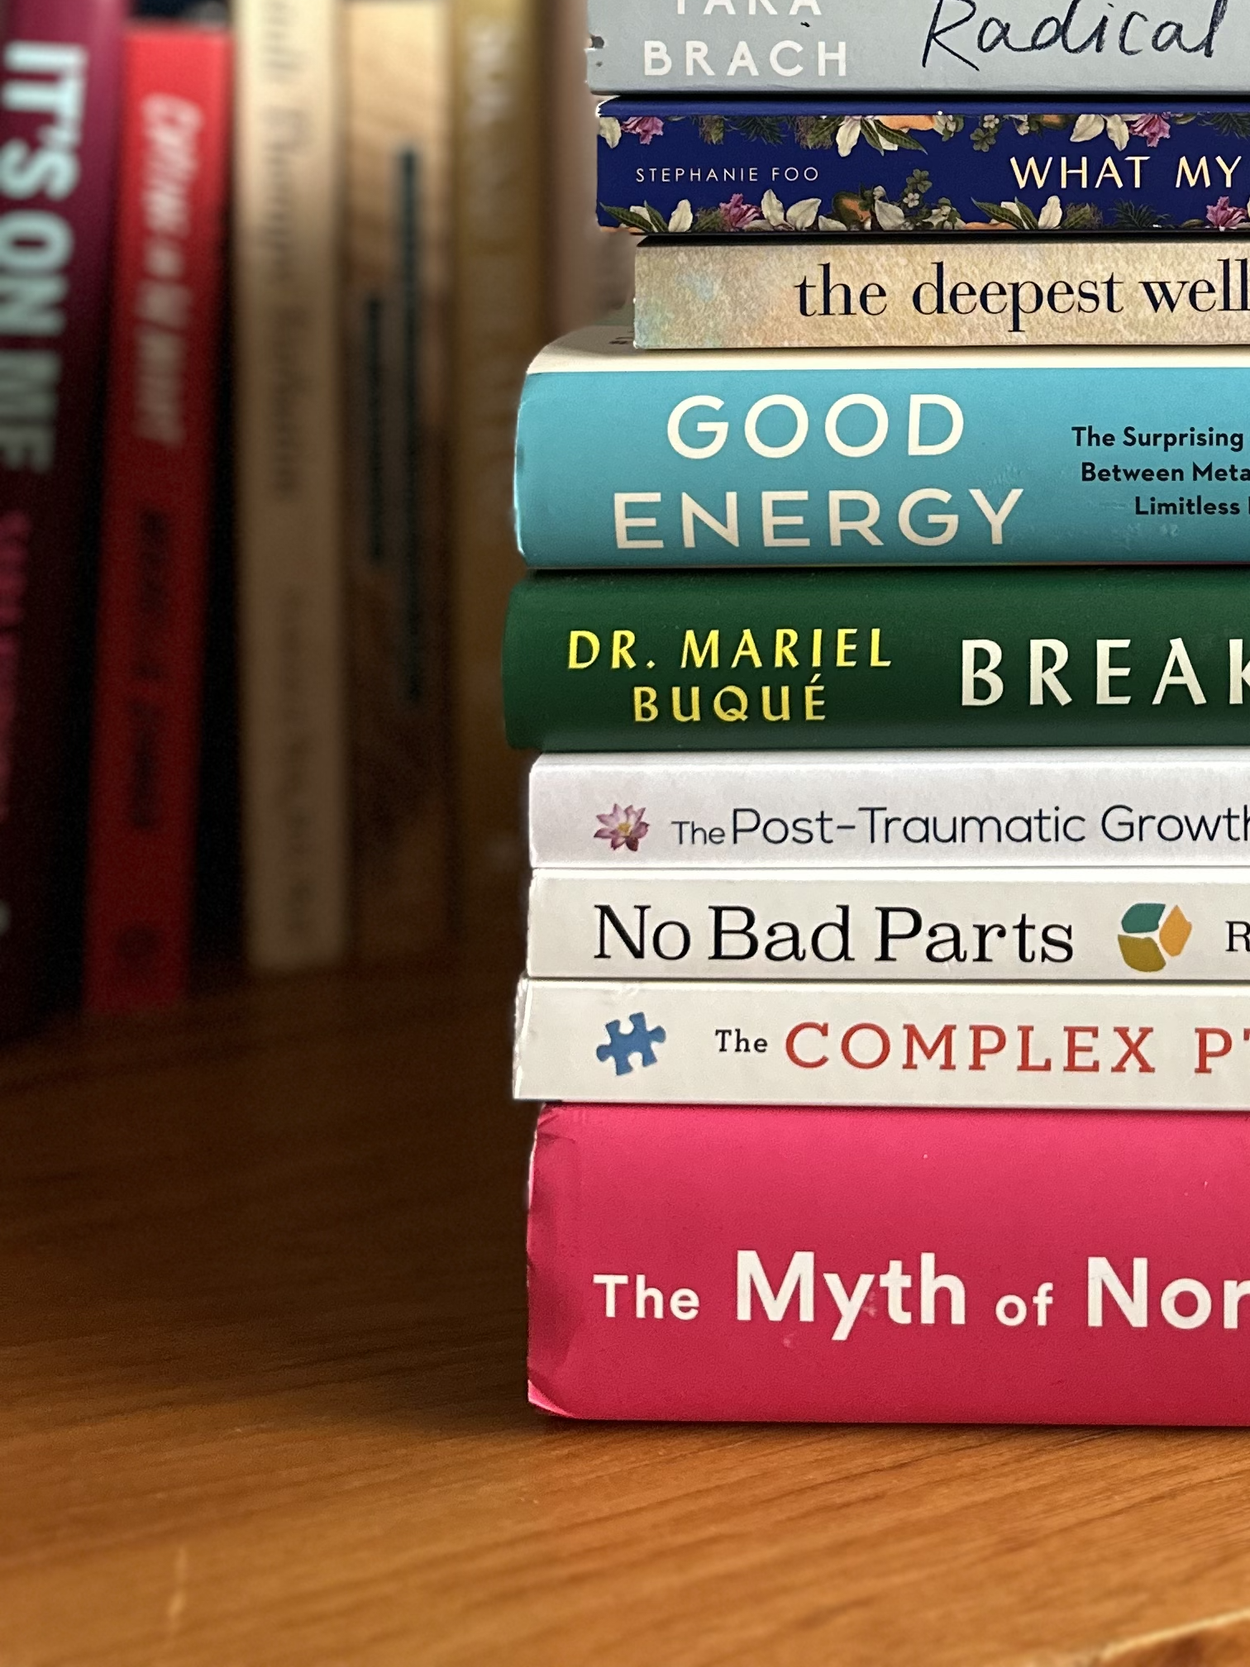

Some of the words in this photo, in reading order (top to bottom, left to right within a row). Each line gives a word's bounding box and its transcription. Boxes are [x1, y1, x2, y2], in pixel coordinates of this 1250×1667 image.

[644, 39, 847, 77] BRACH
[1, 41, 88, 200] IT'S
[635, 167, 758, 183] STEPHANIE
[771, 166, 819, 182] FOO
[1009, 155, 1151, 190] WHAT
[1175, 155, 1242, 188] MY
[0, 209, 74, 336] ON
[793, 262, 888, 317] the
[912, 260, 1124, 333] deepest
[667, 393, 964, 460] GOOD
[1071, 425, 1116, 447] The
[1122, 425, 1244, 453] Surprising
[1081, 461, 1185, 482] Between
[613, 487, 1024, 549] ENERGY
[1135, 494, 1241, 516] Limitless
[568, 629, 656, 669] DR.
[680, 627, 892, 669] MARIEL
[633, 673, 826, 722] BUQUÉ
[670, 820, 726, 845] The
[732, 805, 1086, 845] Post-Traumatic
[593, 904, 691, 961] No
[707, 904, 856, 963] Bad
[874, 906, 1074, 964] Parts
[714, 1028, 768, 1053] The
[785, 1021, 1156, 1074] COMPLEX
[592, 1274, 700, 1321] The
[736, 1250, 966, 1341] Myth
[995, 1282, 1054, 1327] of
